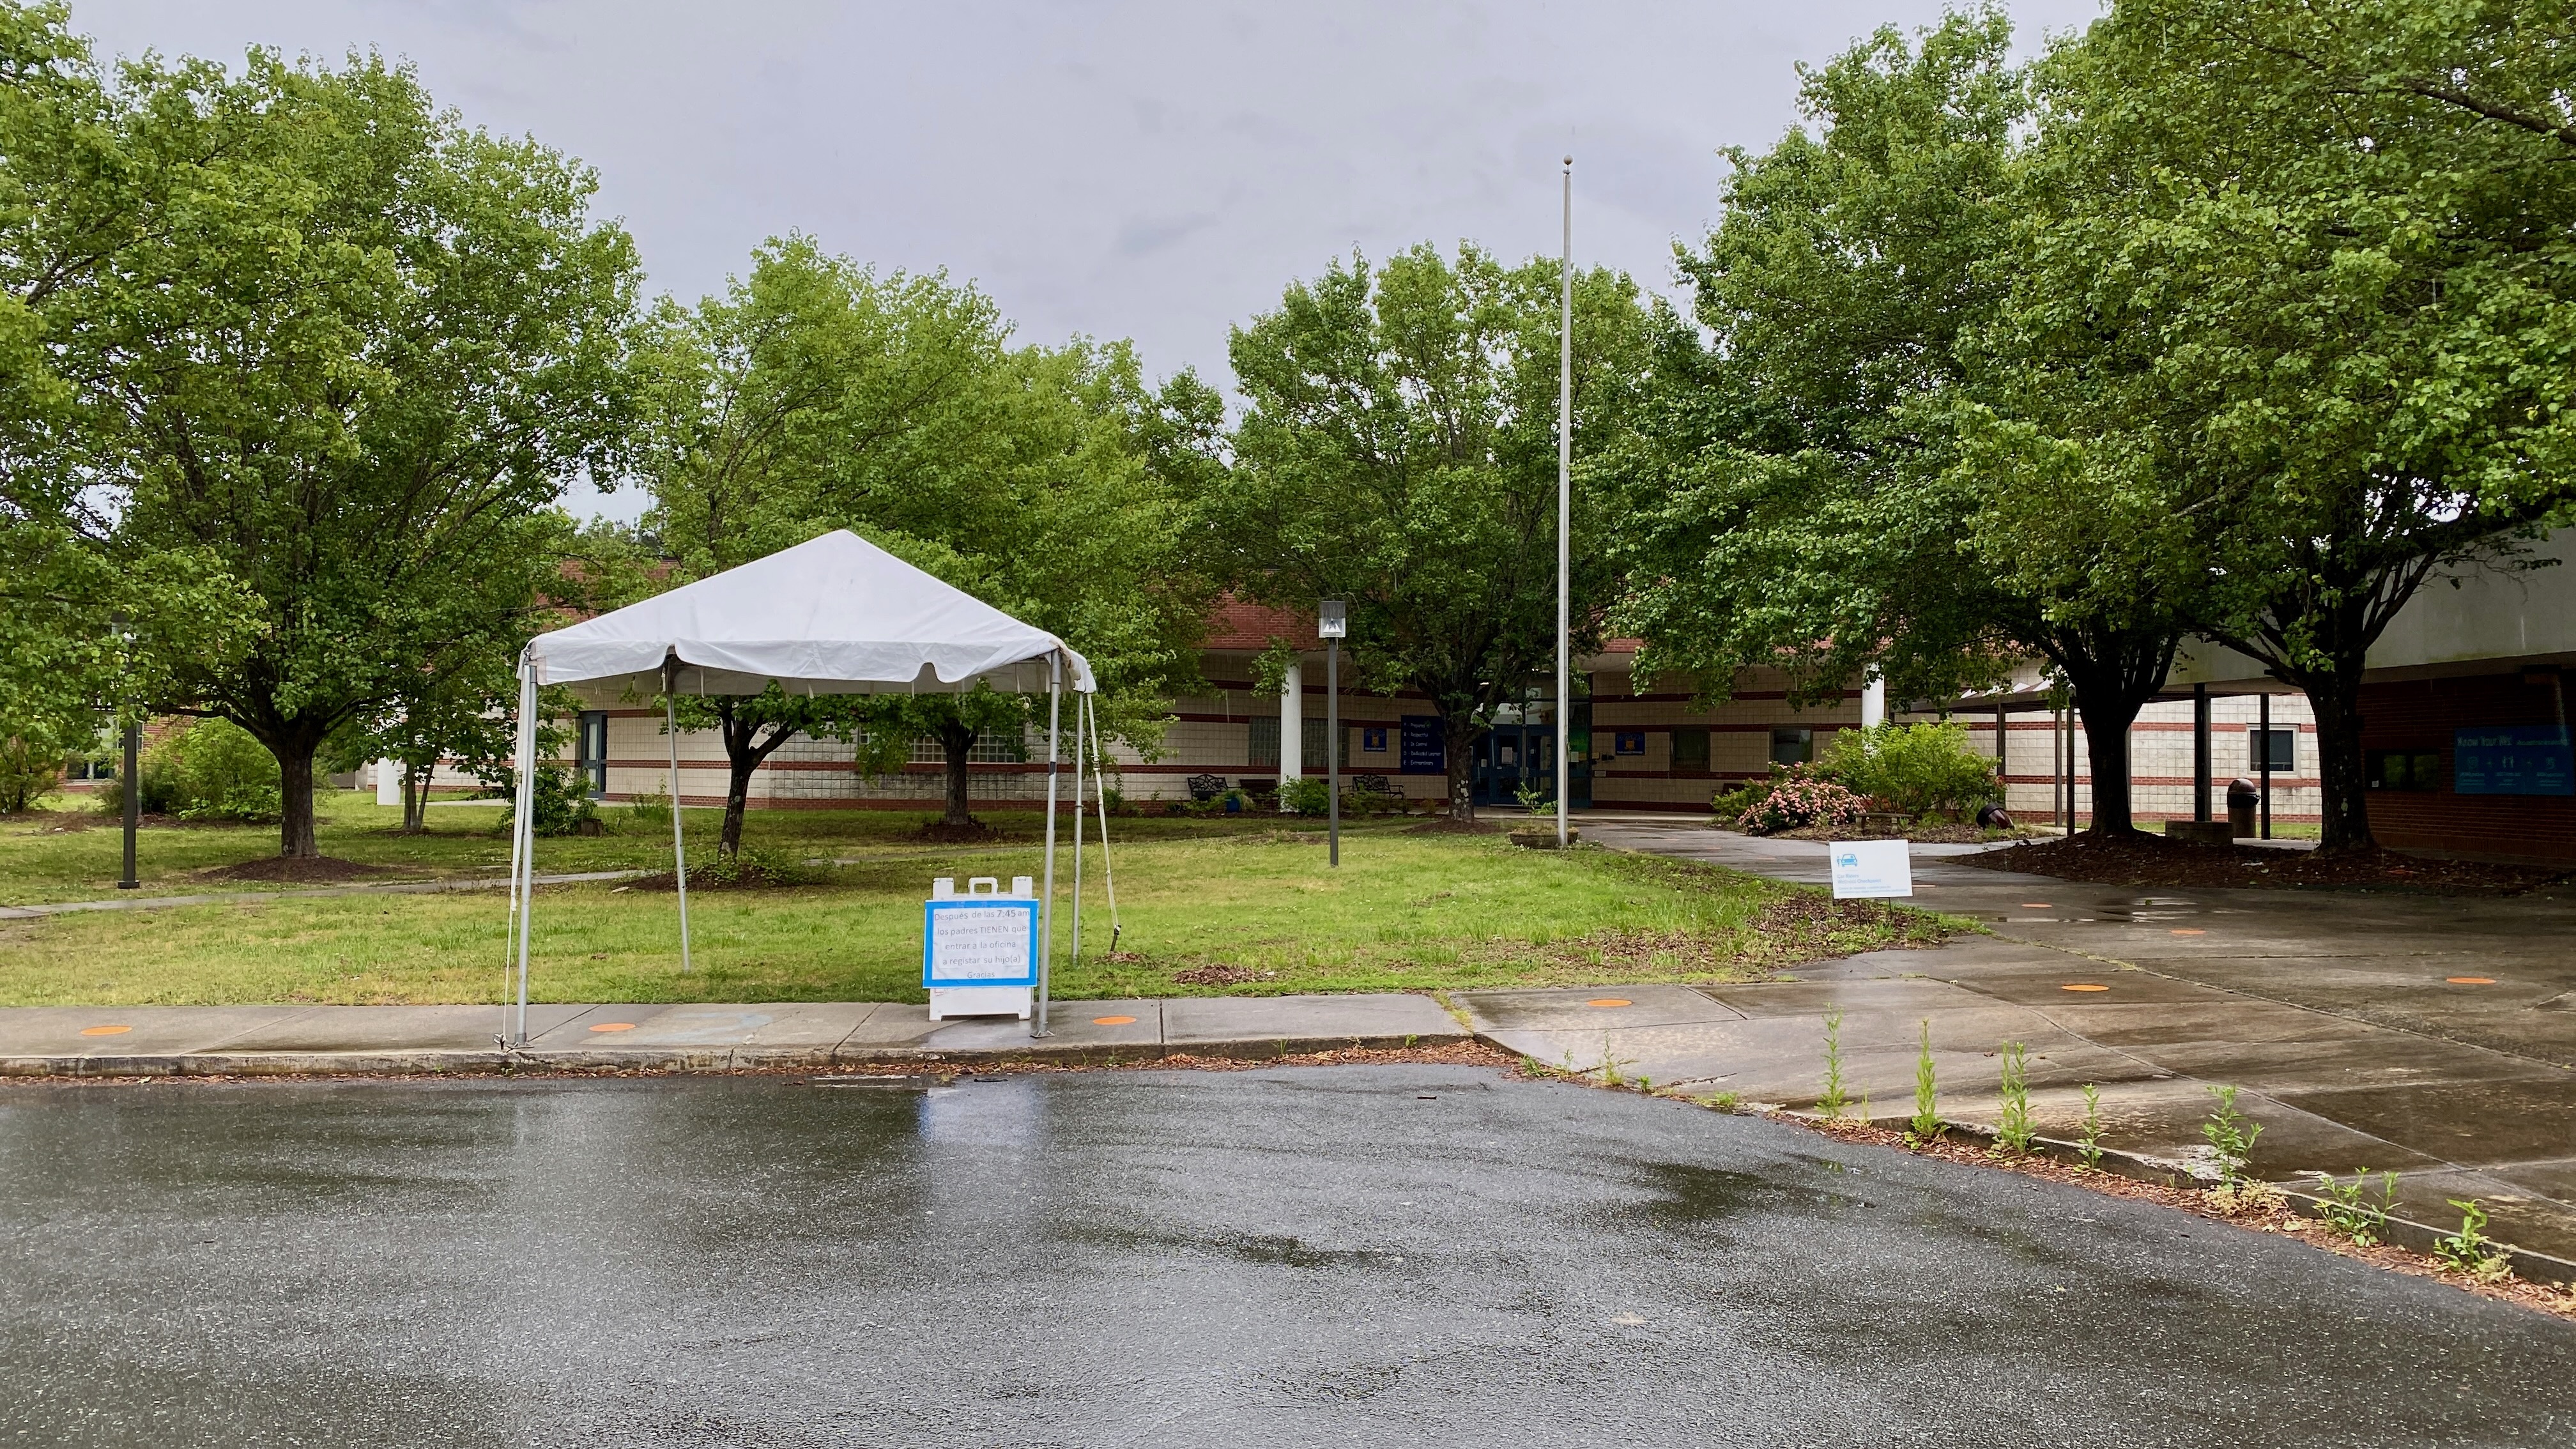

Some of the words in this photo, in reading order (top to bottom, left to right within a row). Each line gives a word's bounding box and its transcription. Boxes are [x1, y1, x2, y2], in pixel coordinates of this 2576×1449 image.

[935, 912, 968, 921] Después
[984, 910, 995, 918] las
[997, 909, 1016, 918] 7:45
[951, 926, 977, 936] padres
[1011, 926, 1027, 934] que
[990, 940, 1016, 949] oficina
[949, 956, 980, 966] registar
[995, 954, 1020, 965] hijo(a)
